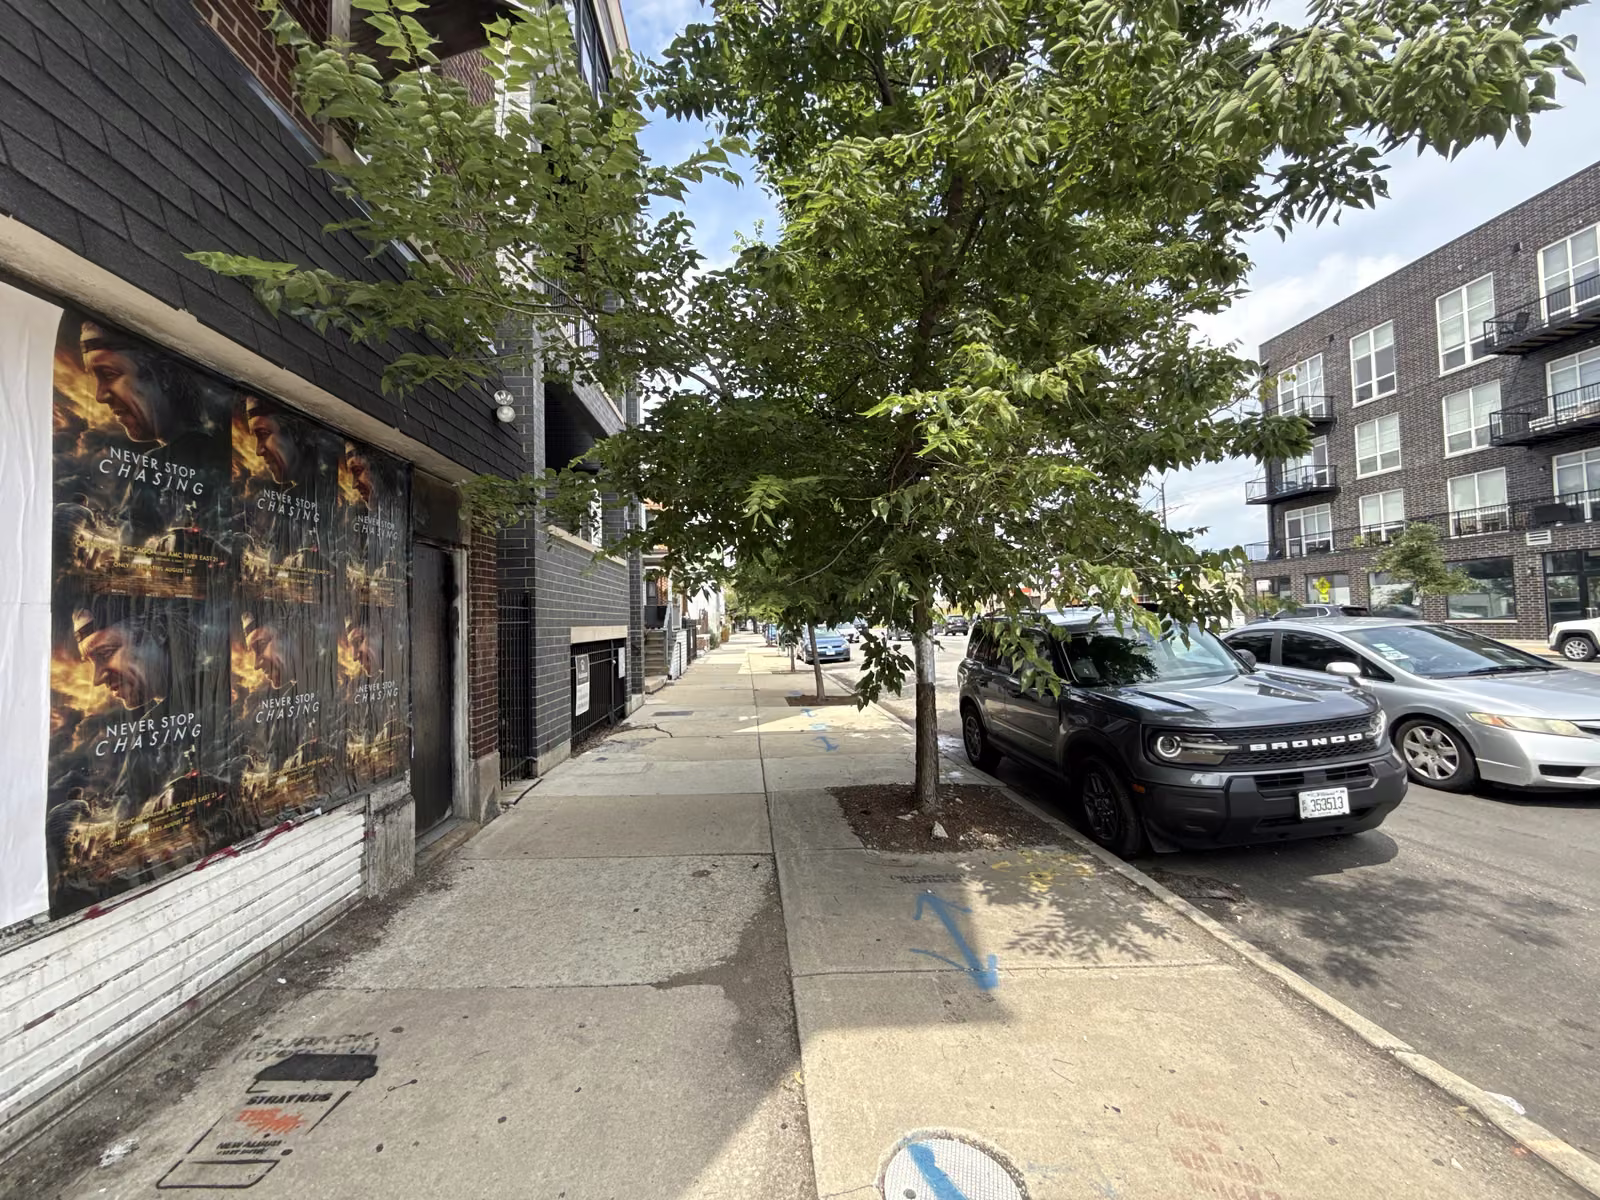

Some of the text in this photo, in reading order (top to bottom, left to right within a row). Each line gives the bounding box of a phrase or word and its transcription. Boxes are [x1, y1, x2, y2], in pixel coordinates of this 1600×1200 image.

[110, 446, 196, 479] NEVER STOP
[99, 459, 204, 495] CHASING
[257, 498, 320, 523] CHASING
[263, 489, 317, 510] NEVER STOP
[256, 701, 320, 723] CHASING
[261, 692, 315, 710] NEVER STOP
[106, 713, 195, 738] NEVER STOP
[95, 724, 201, 756] CHASING
[1249, 733, 1363, 752] BRONCO
[1310, 796, 1344, 812] 353513
